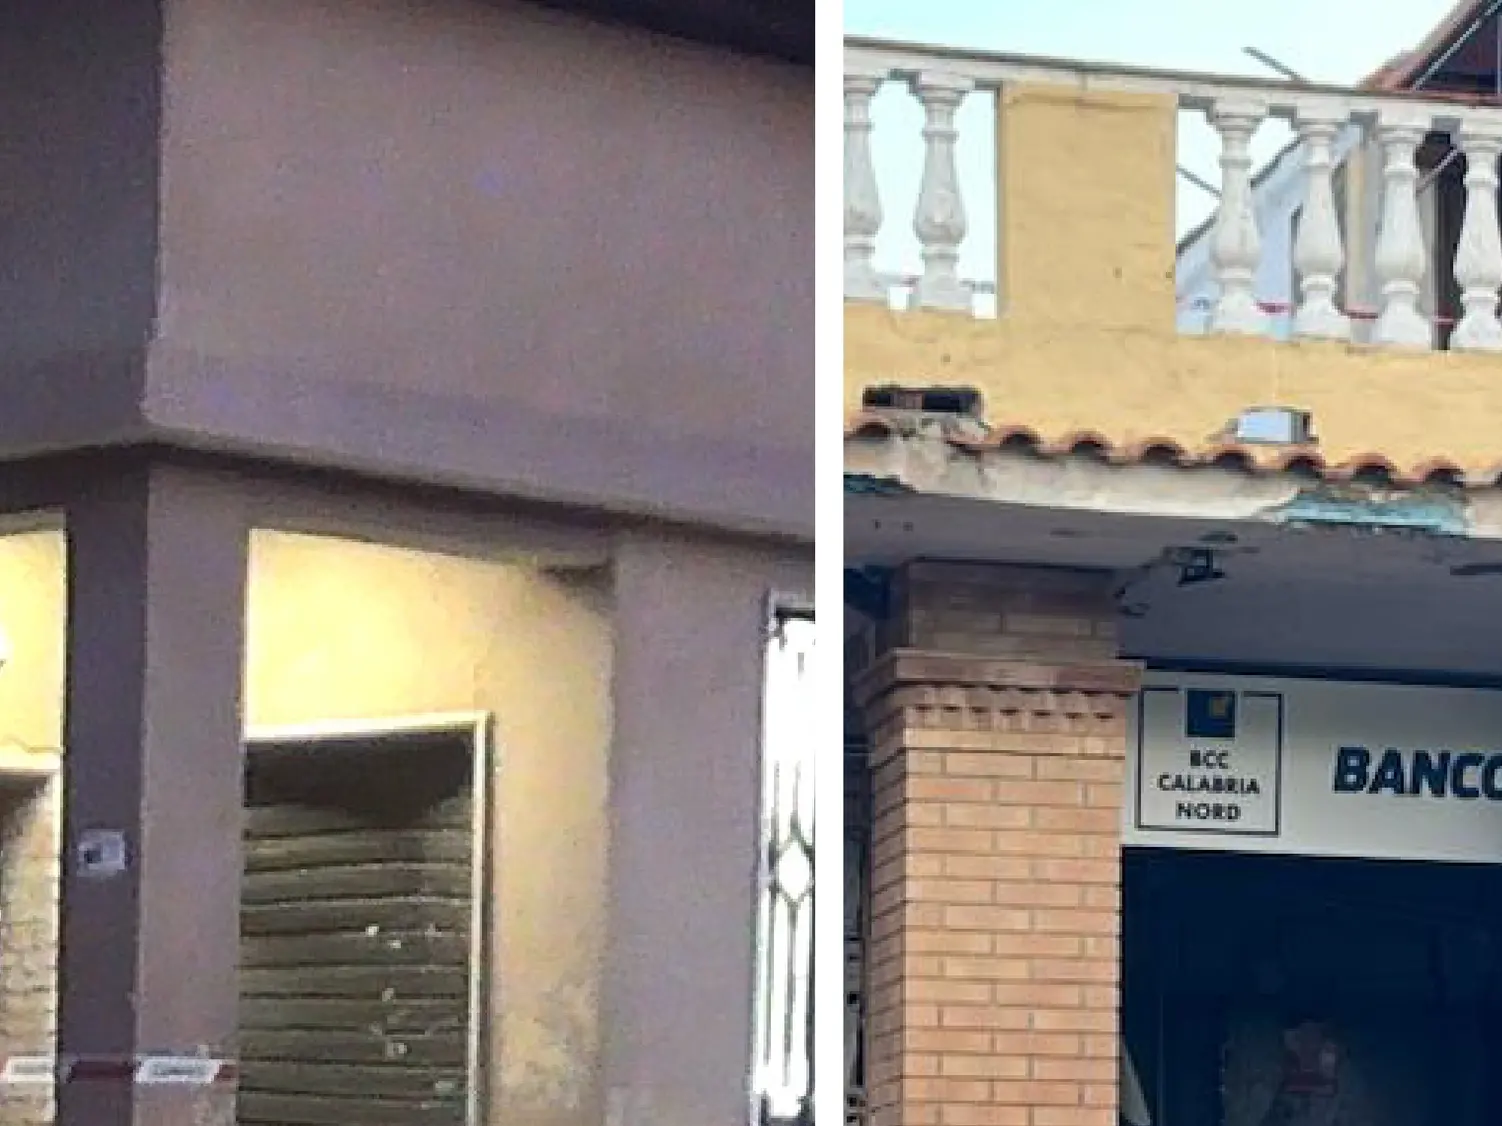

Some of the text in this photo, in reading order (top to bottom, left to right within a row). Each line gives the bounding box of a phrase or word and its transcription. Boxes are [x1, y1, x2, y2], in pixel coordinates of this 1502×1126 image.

[1190, 749, 1229, 769] BCC
[1157, 773, 1260, 795] CALABRIA
[1176, 802, 1242, 821] NORD
